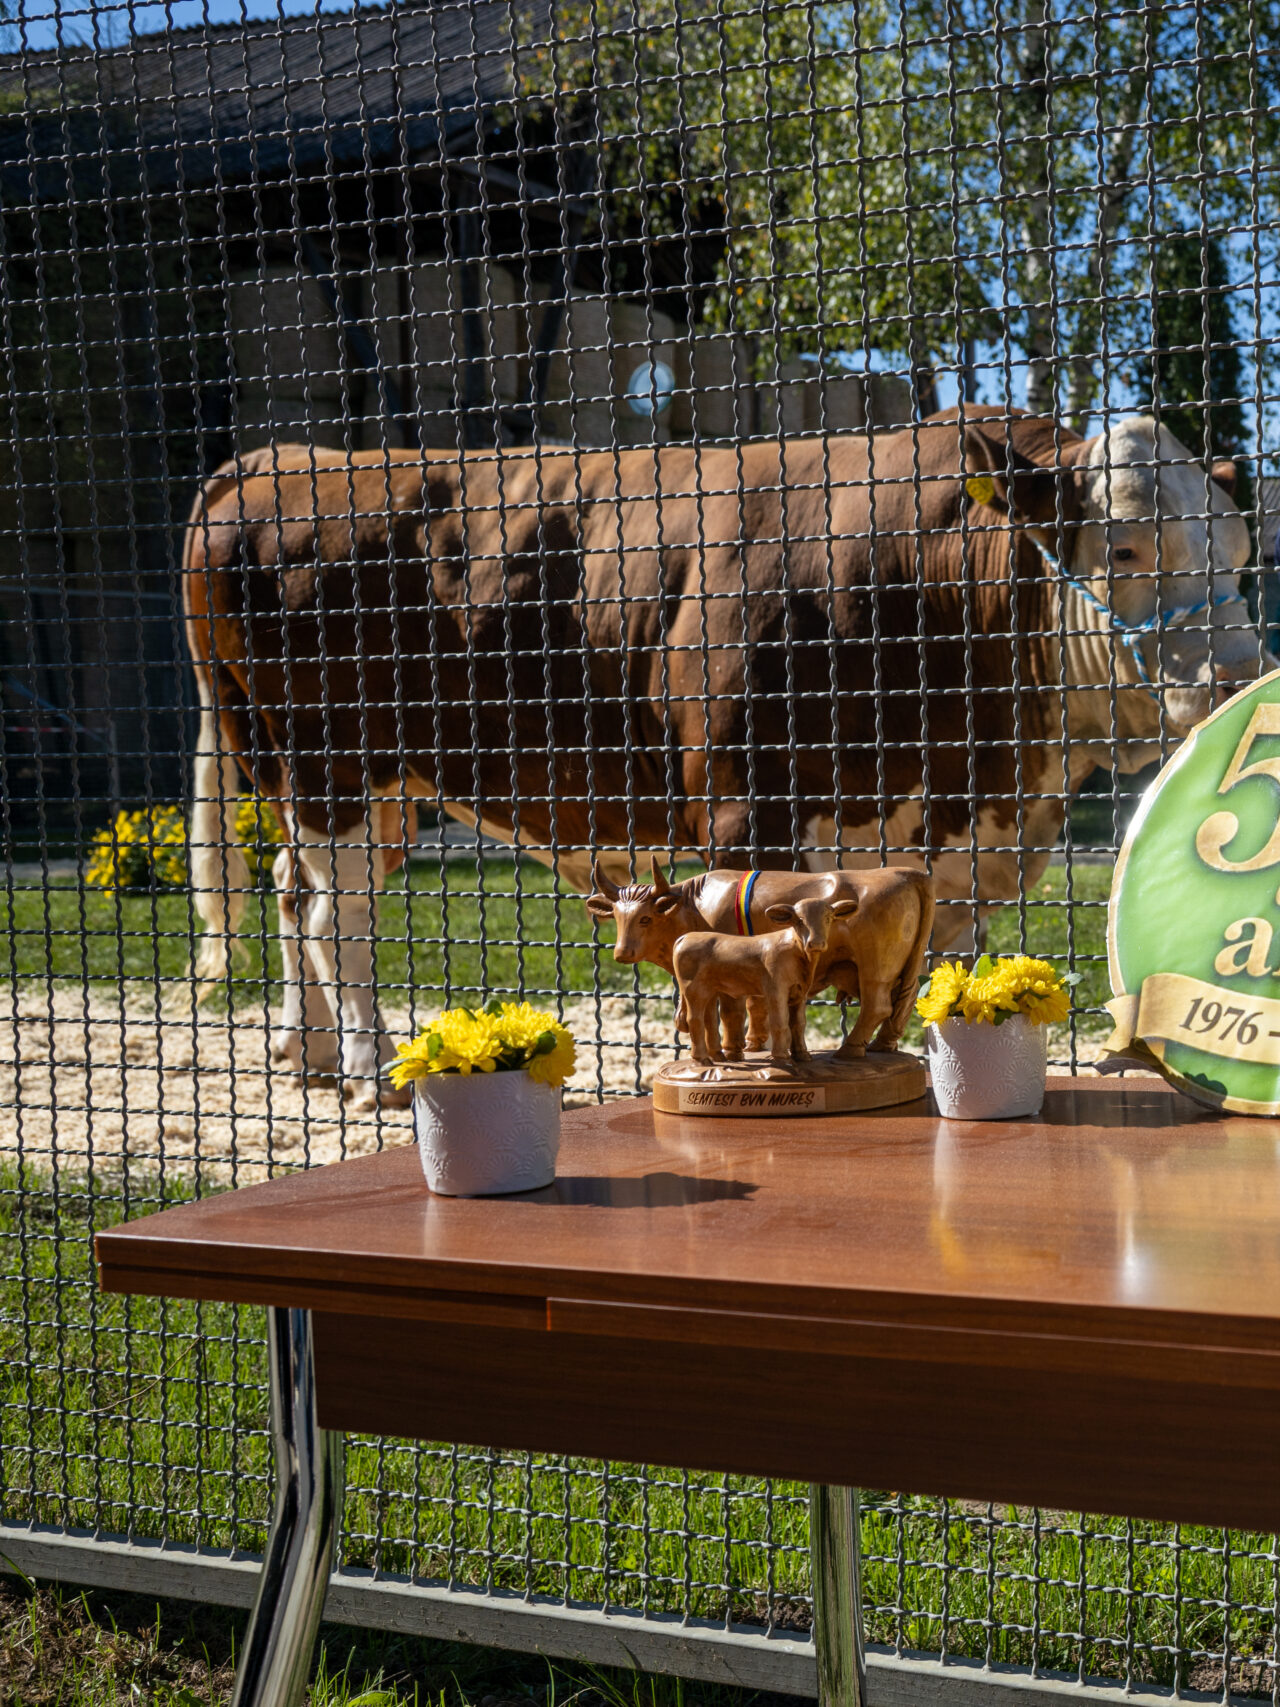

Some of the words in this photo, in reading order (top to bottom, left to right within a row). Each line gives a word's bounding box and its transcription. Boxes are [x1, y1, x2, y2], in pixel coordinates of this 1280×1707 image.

[1179, 997, 1264, 1045] 1976
[688, 1092, 738, 1107] SEMTEST
[740, 1093, 767, 1107] BVN
